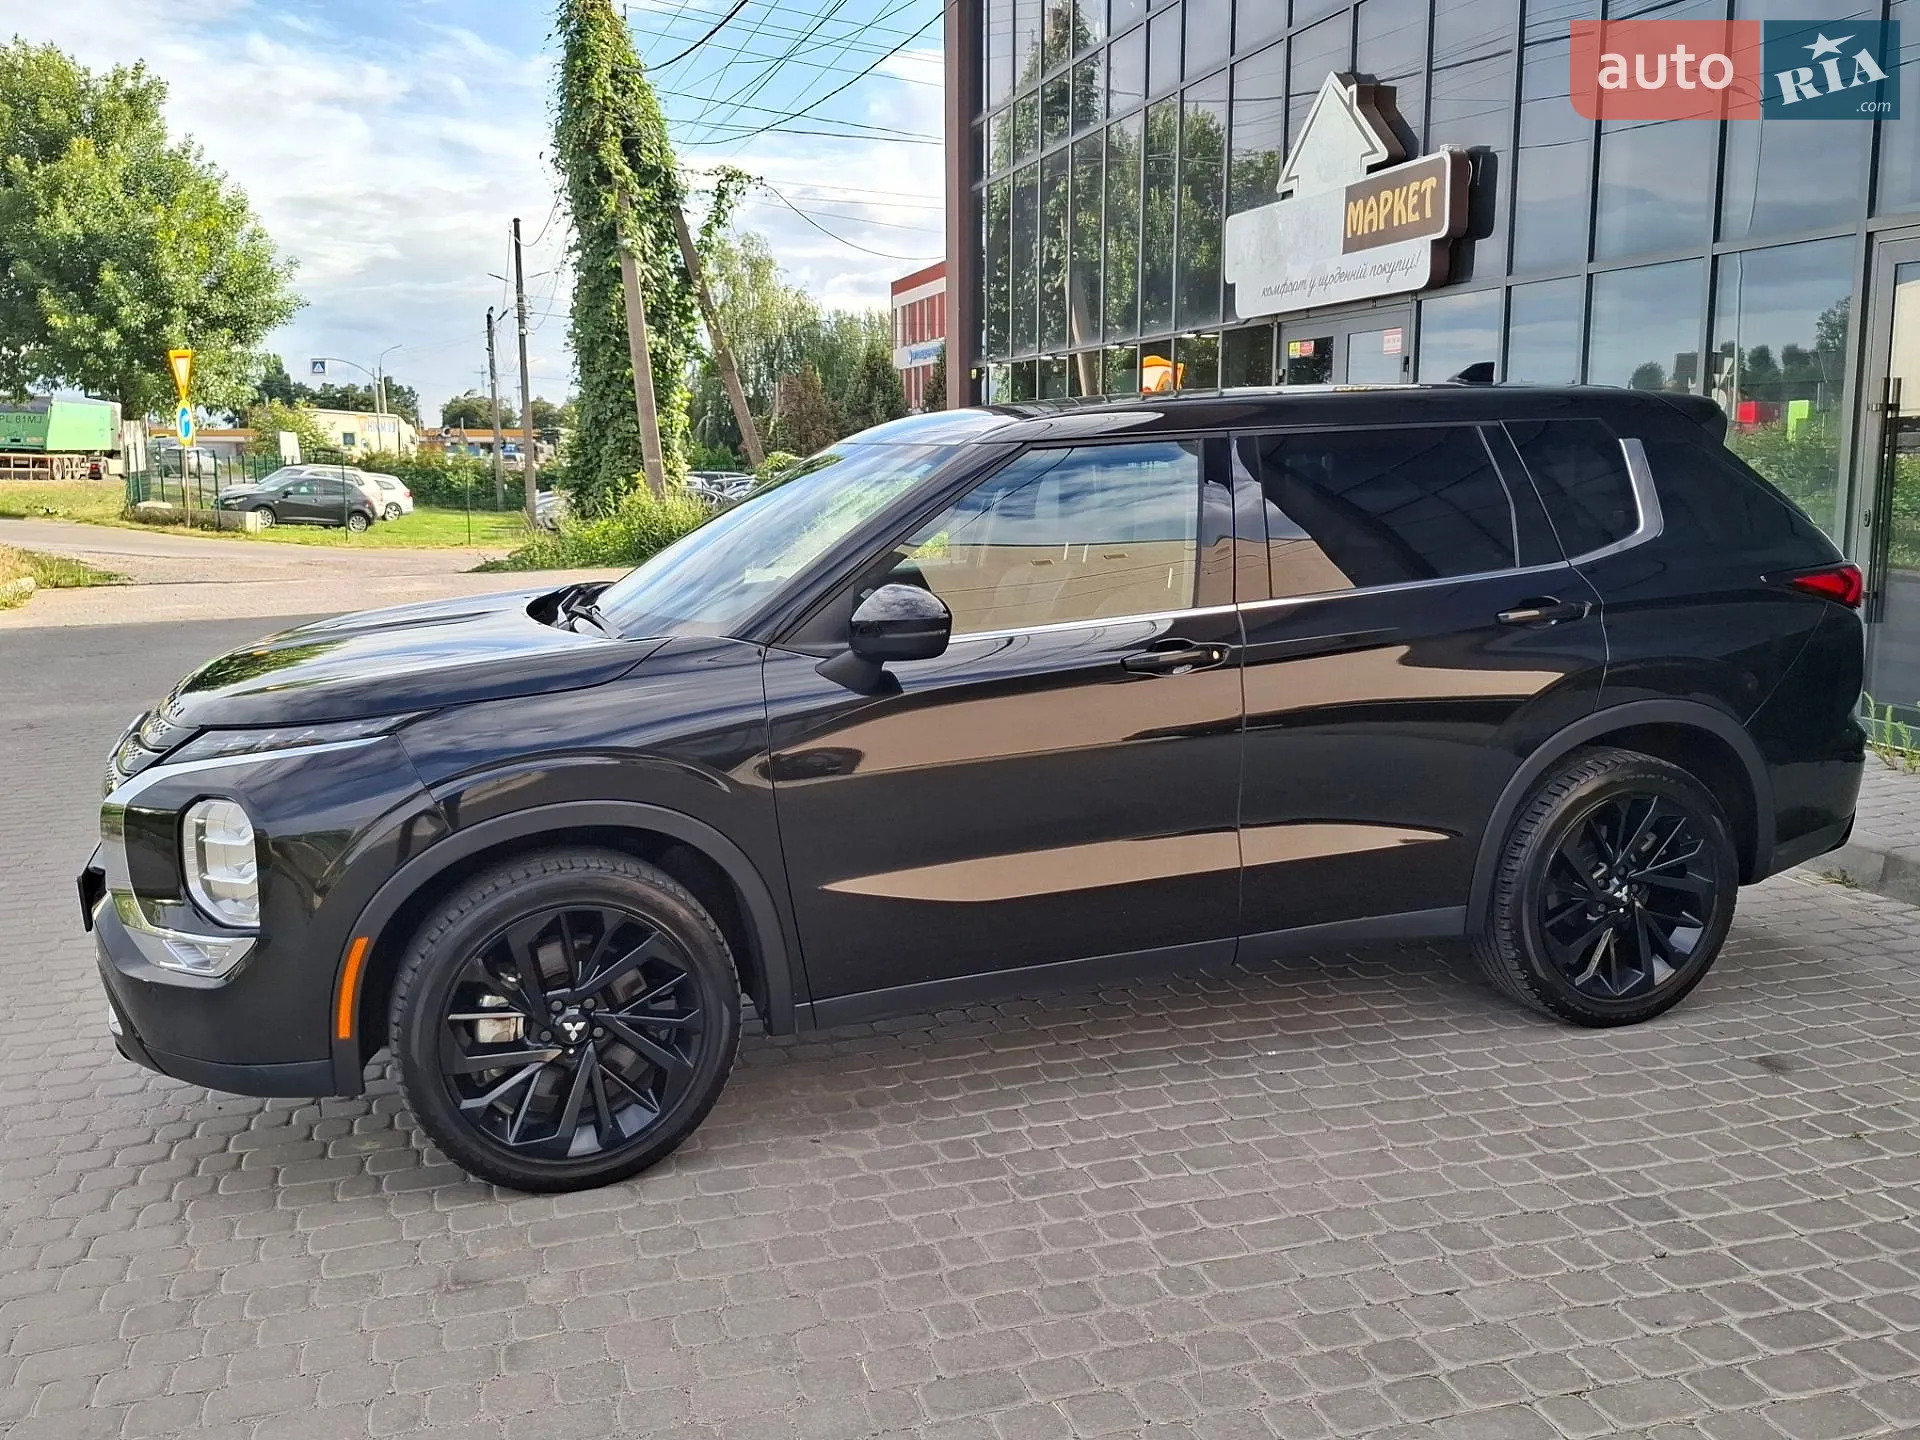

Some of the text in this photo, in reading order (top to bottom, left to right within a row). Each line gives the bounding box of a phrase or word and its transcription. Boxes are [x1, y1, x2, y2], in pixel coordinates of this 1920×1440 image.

[1346, 176, 1438, 239] МАРКЕТ
[1261, 248, 1422, 299] комфорт у щоденній покупці!
